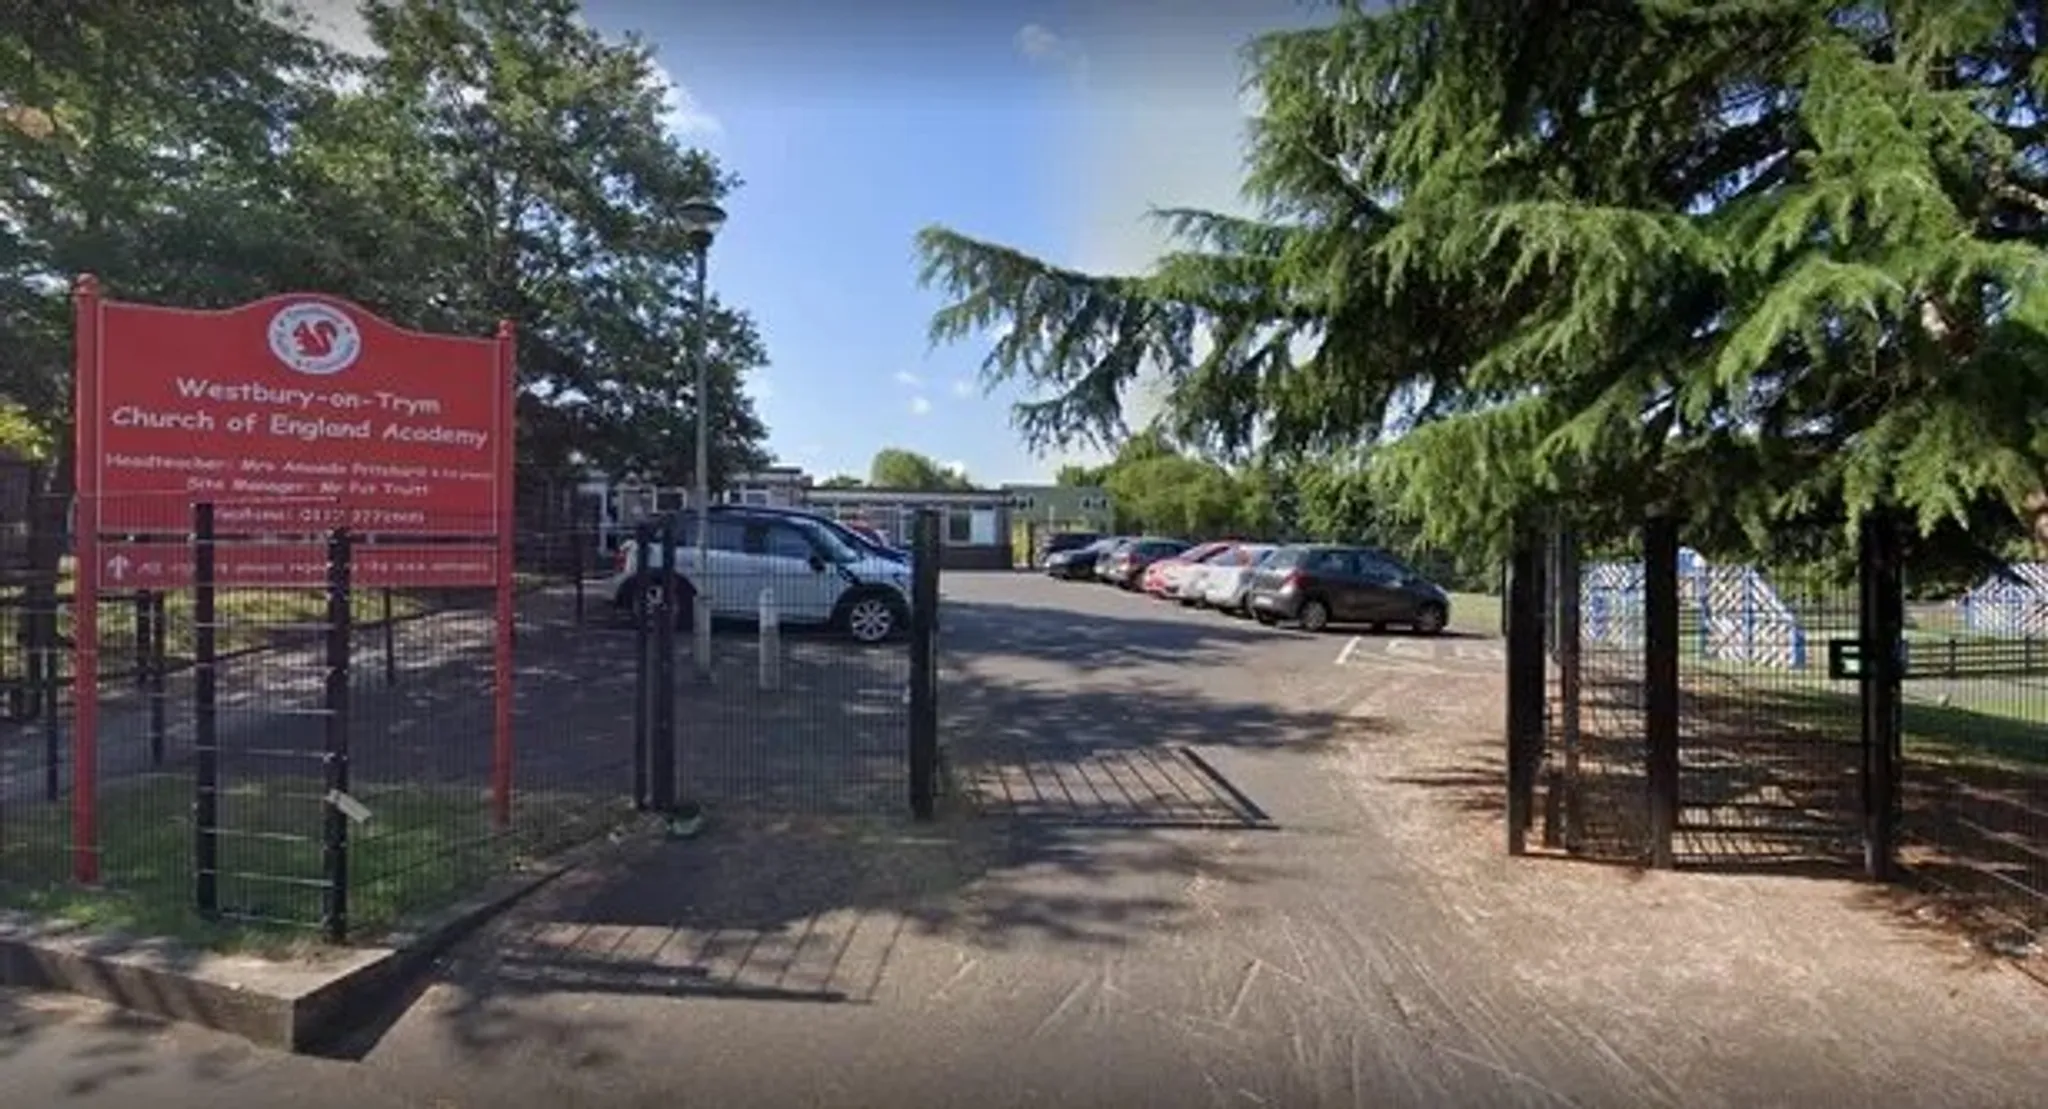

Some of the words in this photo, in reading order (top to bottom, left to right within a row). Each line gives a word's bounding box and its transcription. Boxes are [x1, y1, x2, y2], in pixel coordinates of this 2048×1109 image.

[175, 375, 441, 417] Westbury-on-Trym
[110, 405, 215, 431] Church
[226, 412, 259, 434] of
[269, 413, 371, 442] England
[383, 422, 489, 450] Academy
